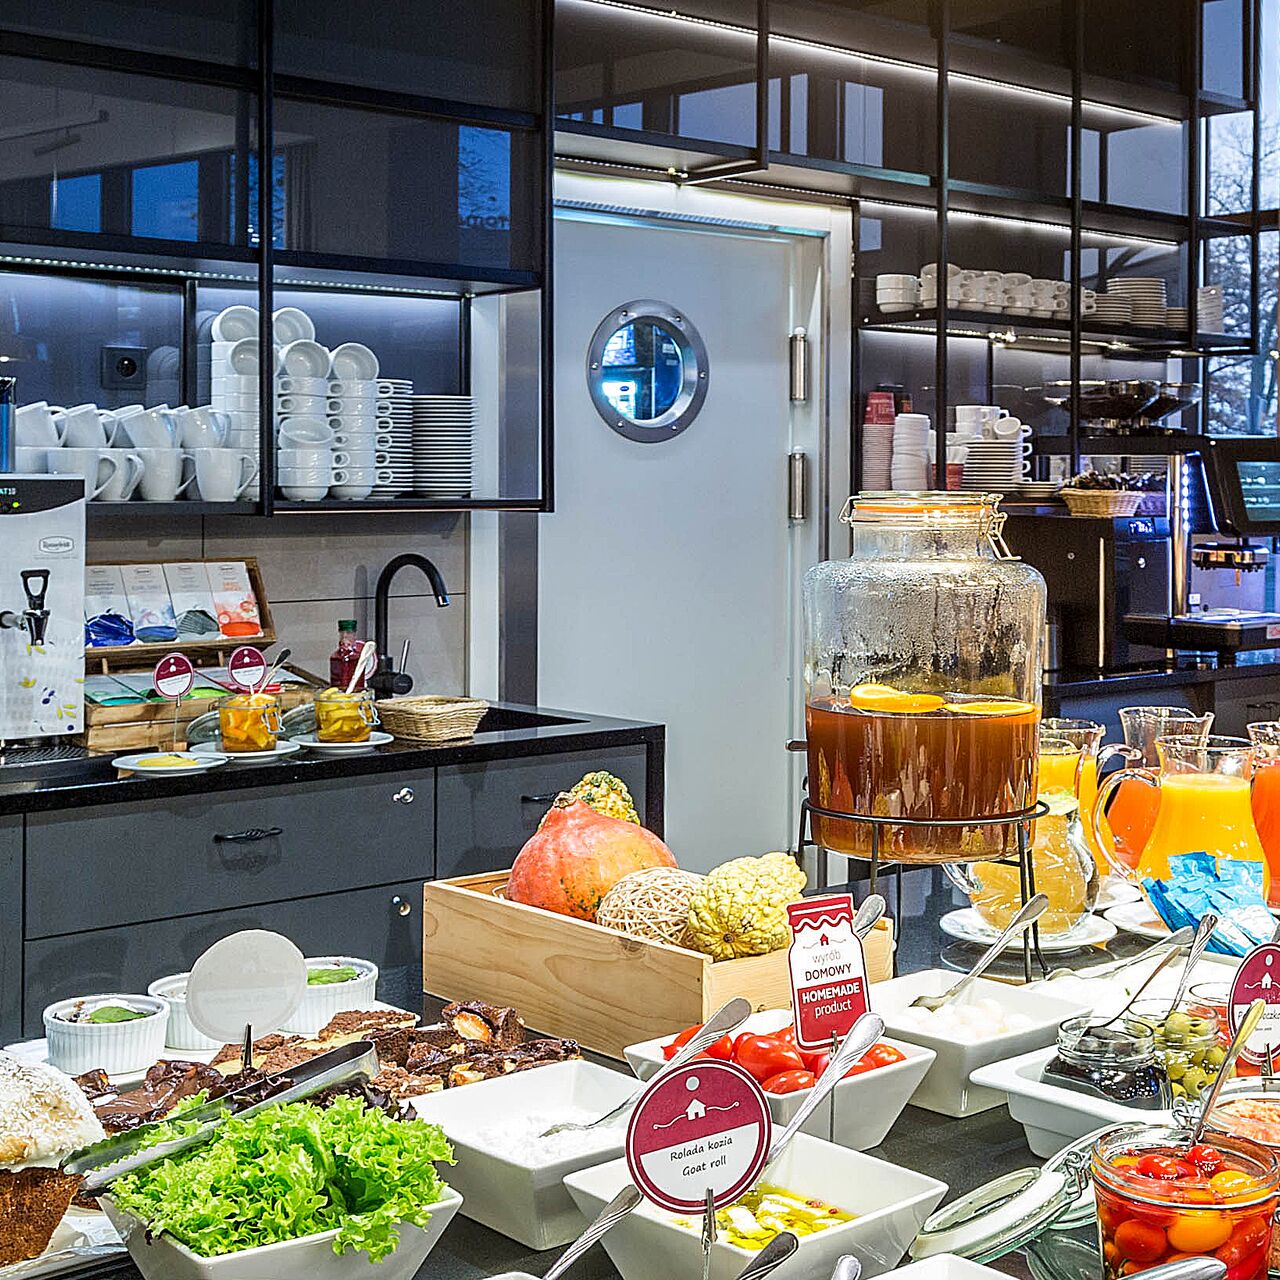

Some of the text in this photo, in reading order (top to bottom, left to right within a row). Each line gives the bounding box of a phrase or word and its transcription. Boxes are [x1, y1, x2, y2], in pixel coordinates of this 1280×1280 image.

[804, 963, 852, 982] DOMOWY
[801, 981, 861, 1005] HOMEMADE
[814, 998, 852, 1019] product
[670, 1136, 733, 1162] Rolada kozia
[682, 1155, 727, 1177] Goat roll
